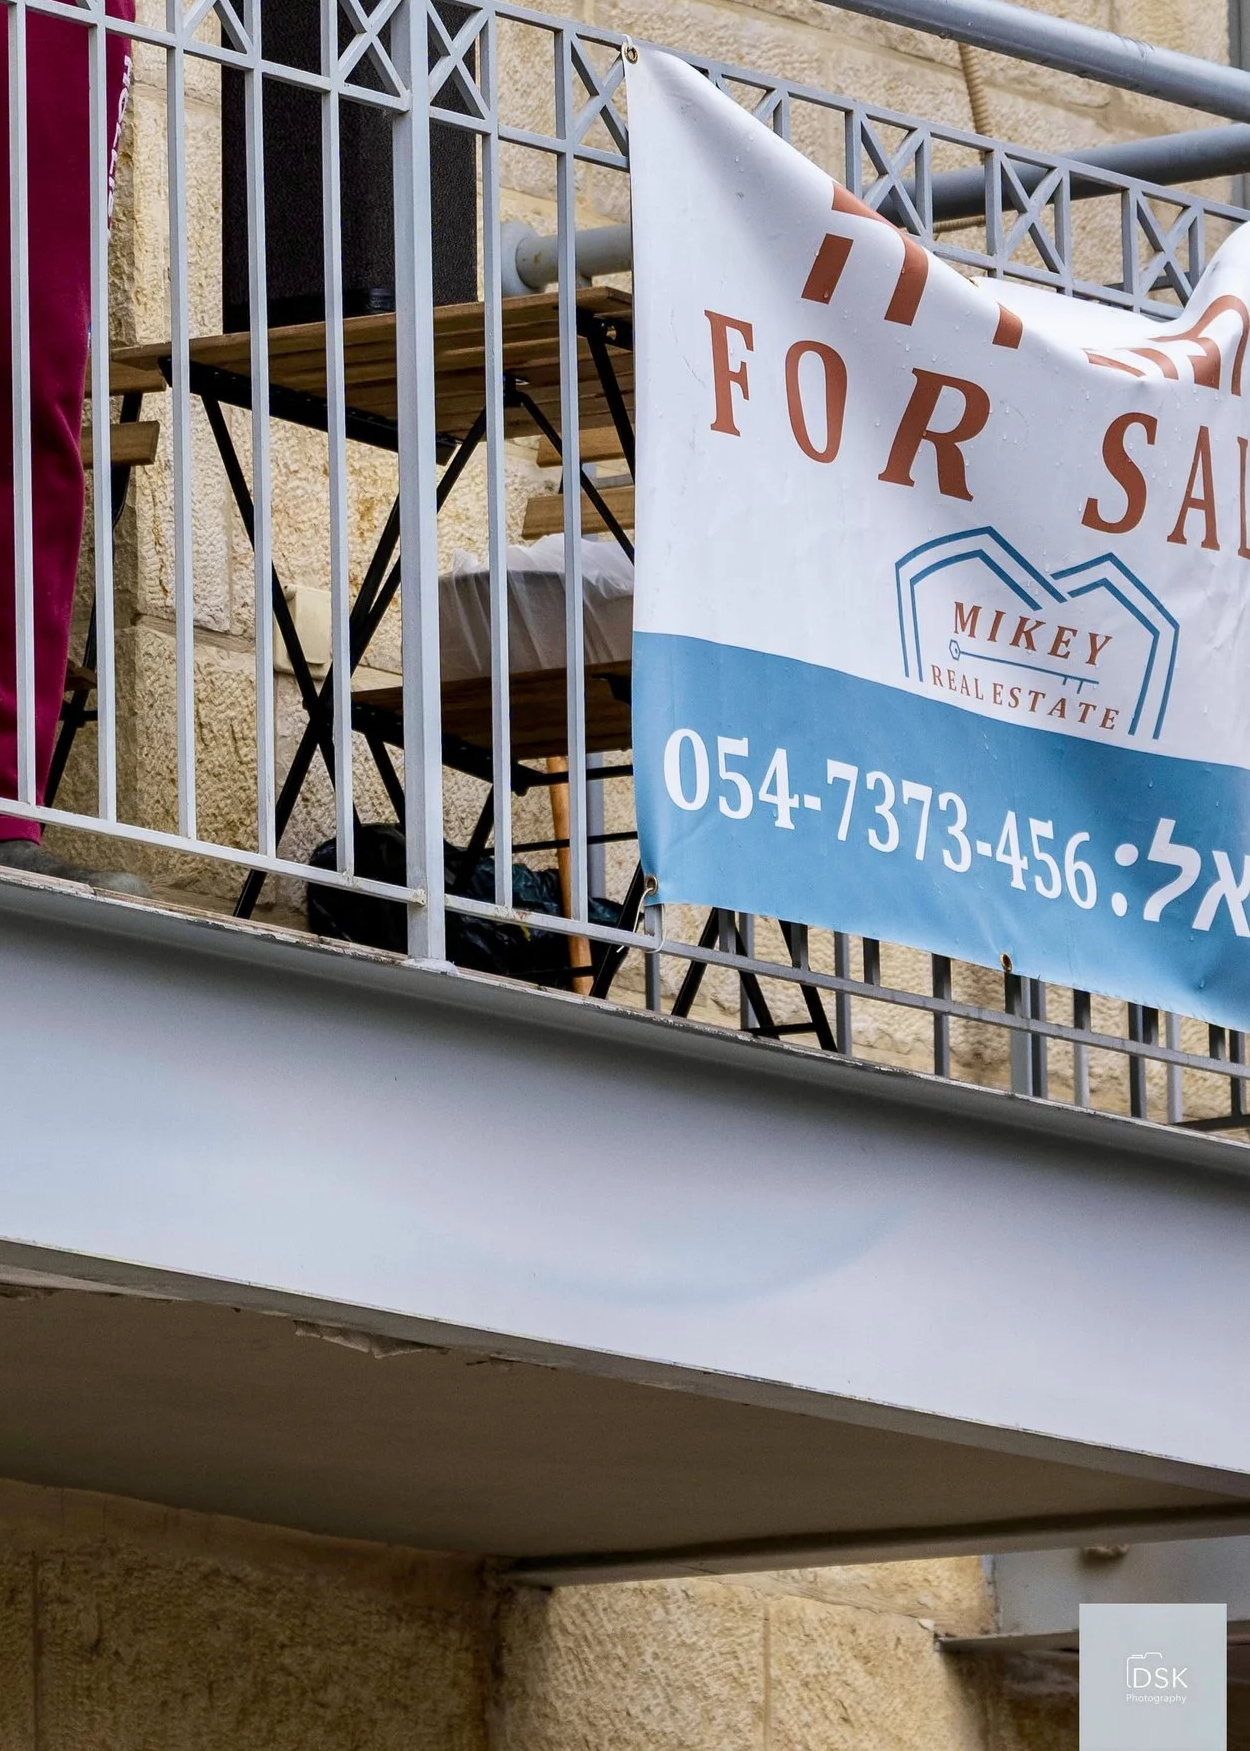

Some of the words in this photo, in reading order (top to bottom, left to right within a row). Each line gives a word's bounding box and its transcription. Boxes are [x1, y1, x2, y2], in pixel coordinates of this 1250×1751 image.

[703, 309, 992, 502] FOR
[953, 601, 1113, 666] MIKEY
[931, 664, 984, 700] REAL
[992, 682, 1120, 730] ESTATE
[663, 728, 1098, 911] 054-7373-456
